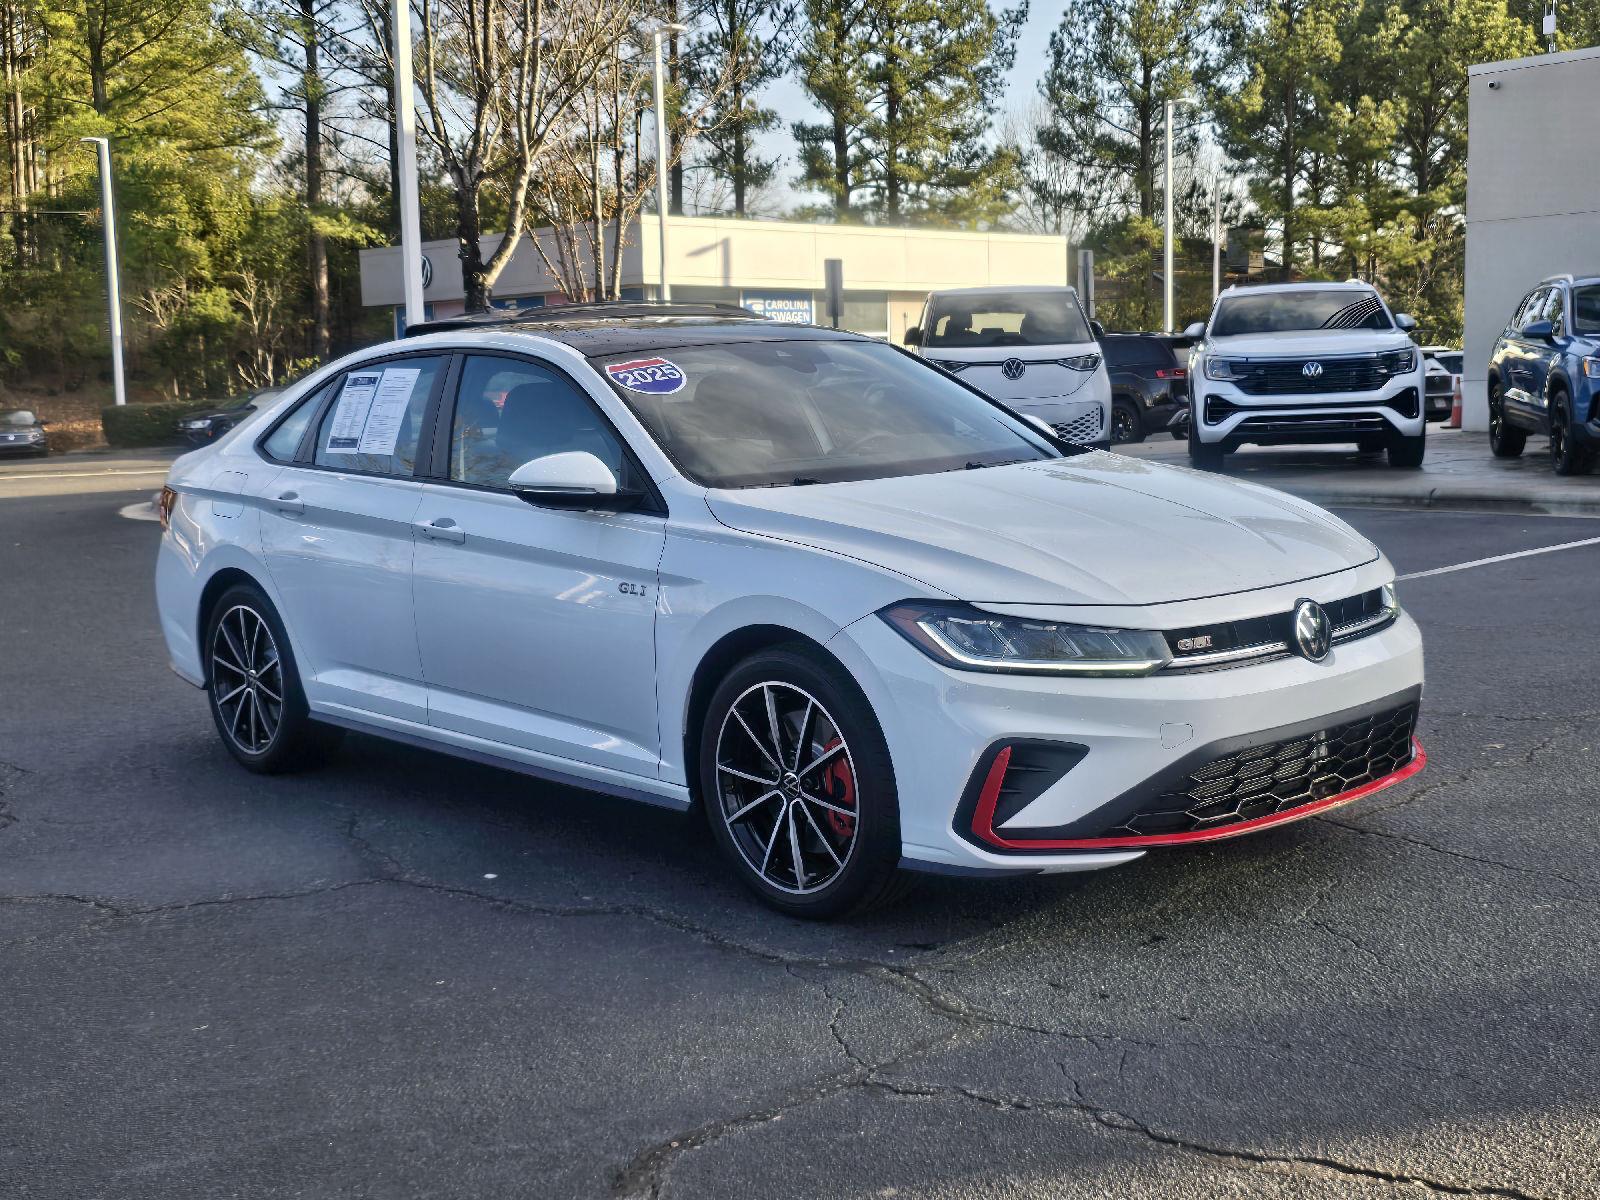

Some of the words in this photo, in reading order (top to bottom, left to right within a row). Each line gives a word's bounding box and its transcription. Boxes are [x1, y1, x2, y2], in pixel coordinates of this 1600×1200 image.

[765, 299, 809, 310] CAROLINA
[754, 311, 811, 323] KSWAGEN
[618, 365, 681, 386] 2025
[618, 581, 647, 597] GLI
[1177, 635, 1213, 651] GLI
